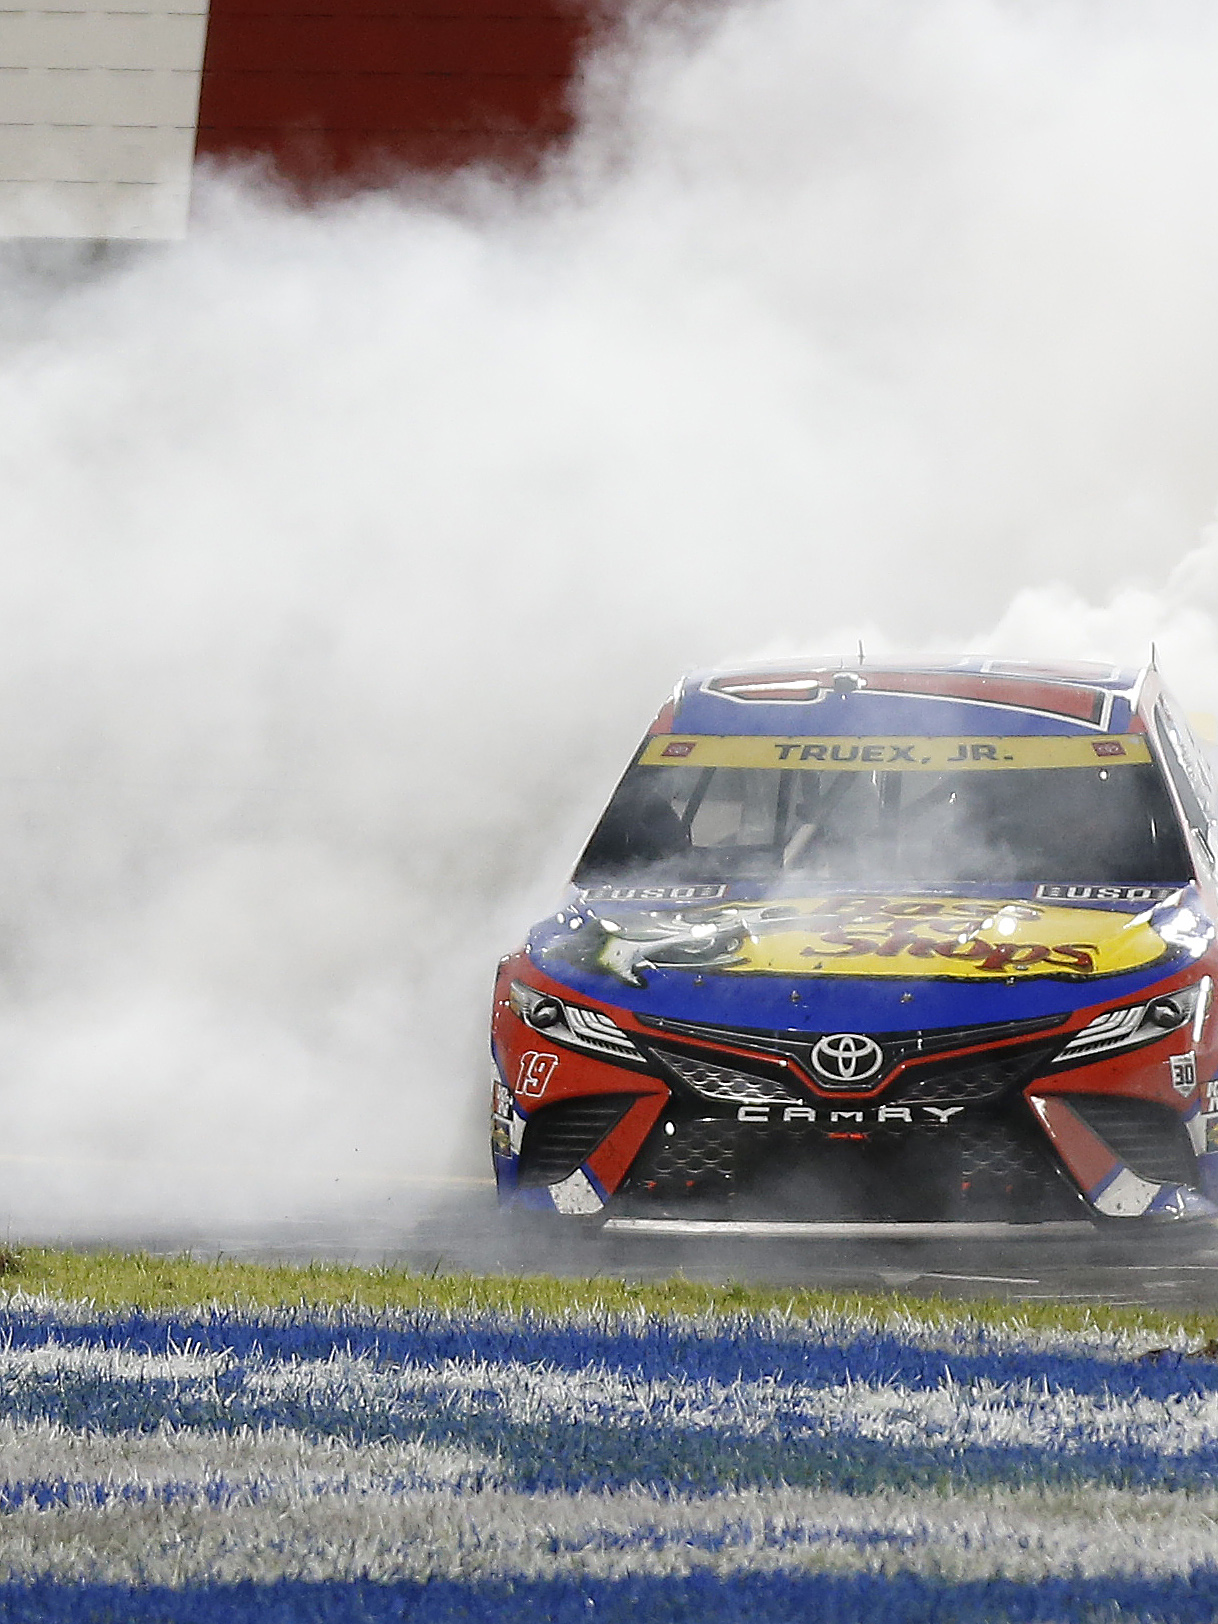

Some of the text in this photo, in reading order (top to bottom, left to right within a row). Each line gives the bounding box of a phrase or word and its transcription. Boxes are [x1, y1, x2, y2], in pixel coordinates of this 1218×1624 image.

[775, 743, 1014, 764] TRUEX, JR.
[799, 929, 1099, 973] Shops
[514, 1050, 559, 1098] 19
[1173, 1063, 1195, 1086] 30
[736, 1105, 965, 1124] CAMRY
